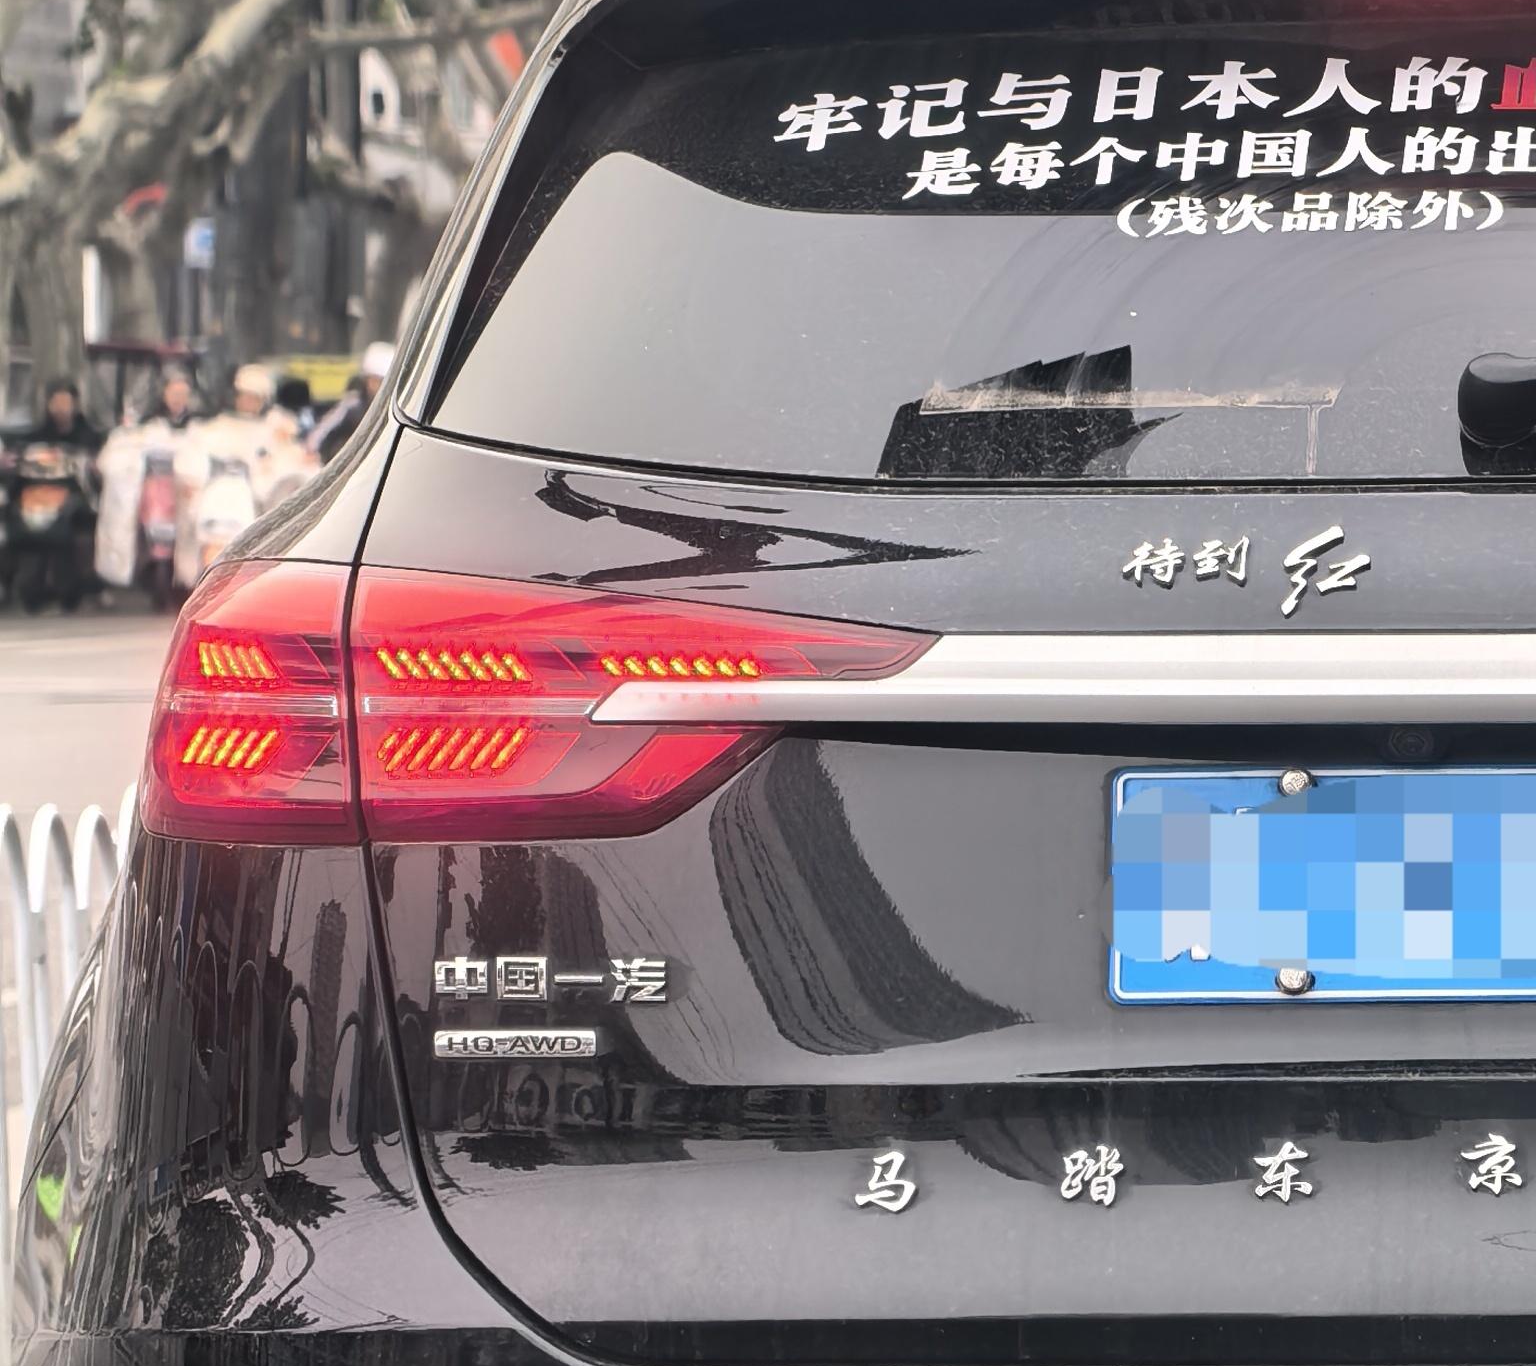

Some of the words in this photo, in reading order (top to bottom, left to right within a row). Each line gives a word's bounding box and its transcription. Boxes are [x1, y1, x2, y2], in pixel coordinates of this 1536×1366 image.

[435, 956, 667, 1002] 中国一汽
[447, 1035, 582, 1054] HQ-AWD
